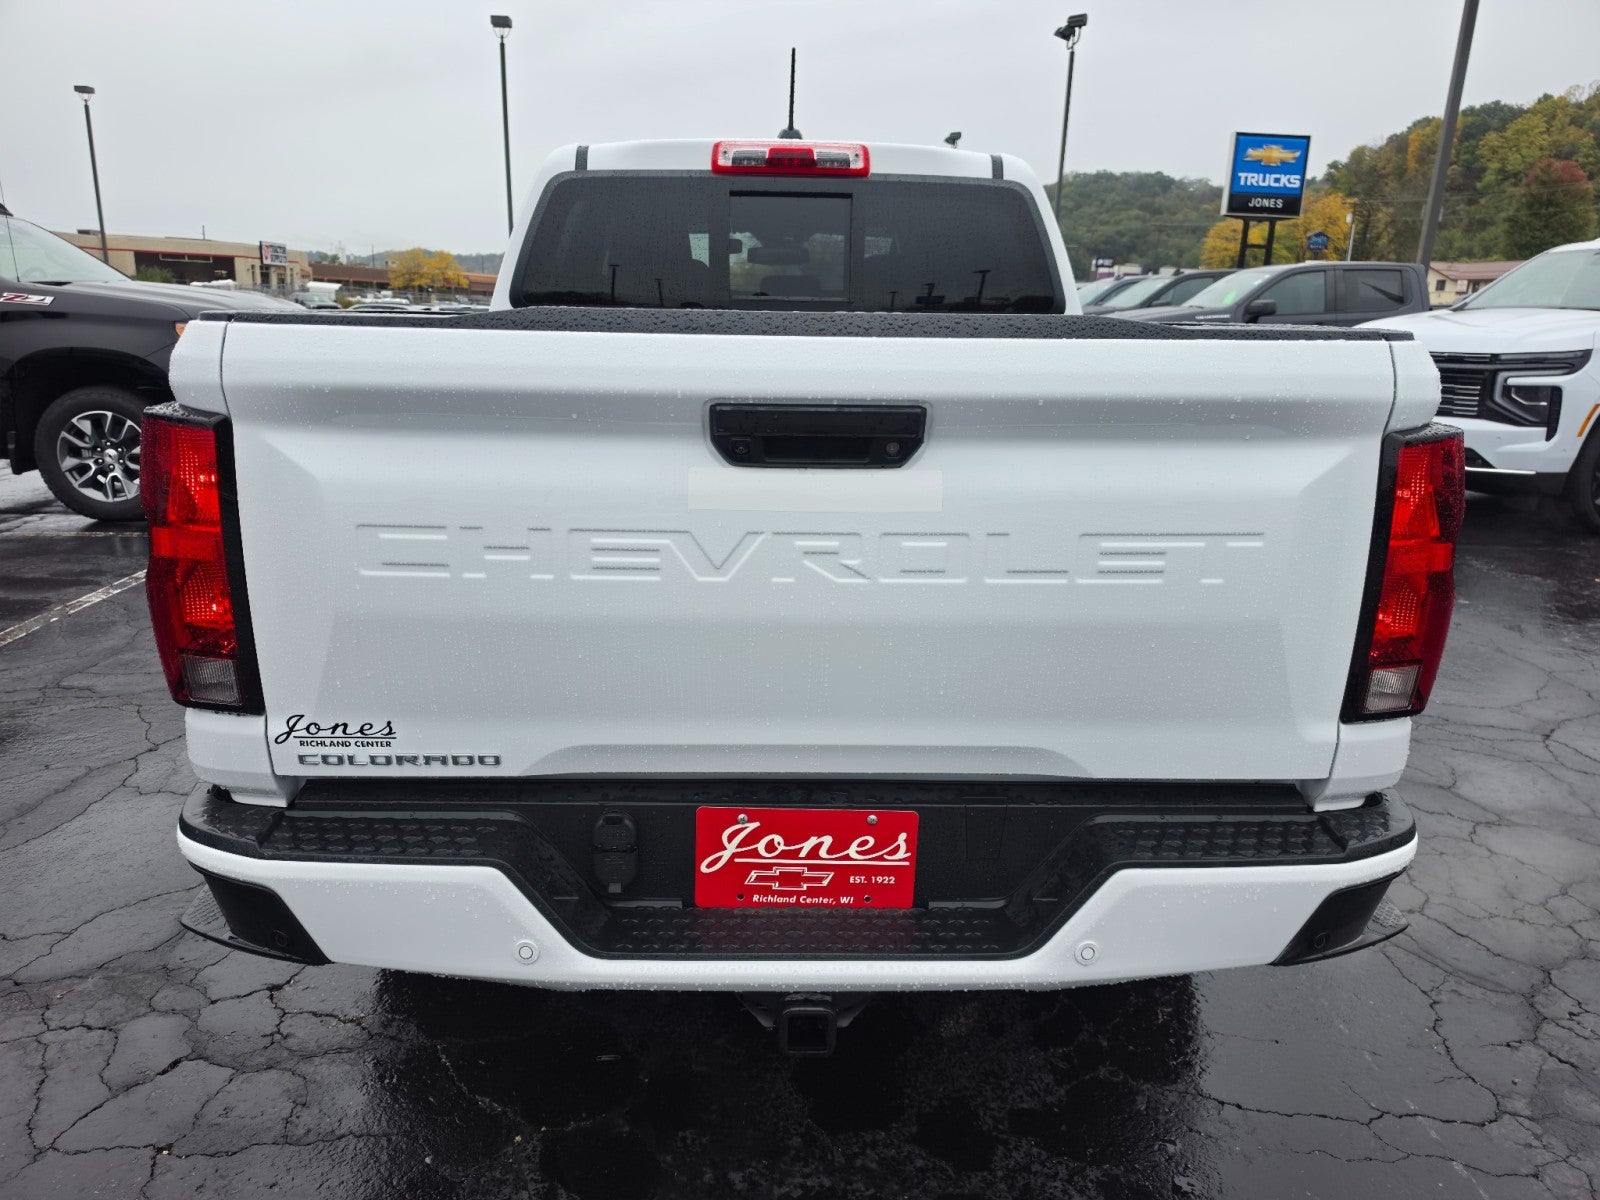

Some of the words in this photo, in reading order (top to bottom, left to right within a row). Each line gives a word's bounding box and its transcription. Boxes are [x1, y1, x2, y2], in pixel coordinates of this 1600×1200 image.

[1238, 172, 1302, 188] TRUCKS
[1248, 197, 1284, 209] JONES
[356, 524, 1265, 584] CHEVROLET
[274, 714, 397, 744] Jones
[299, 740, 351, 748] RICHLAND
[354, 740, 392, 748] CENTER
[297, 753, 502, 766] COLORADO
[700, 821, 912, 874] Jones
[849, 876, 868, 884] EST.
[871, 876, 896, 884] 1922
[752, 894, 797, 904] Richland
[799, 895, 837, 905] Center,
[839, 896, 855, 904] WI
